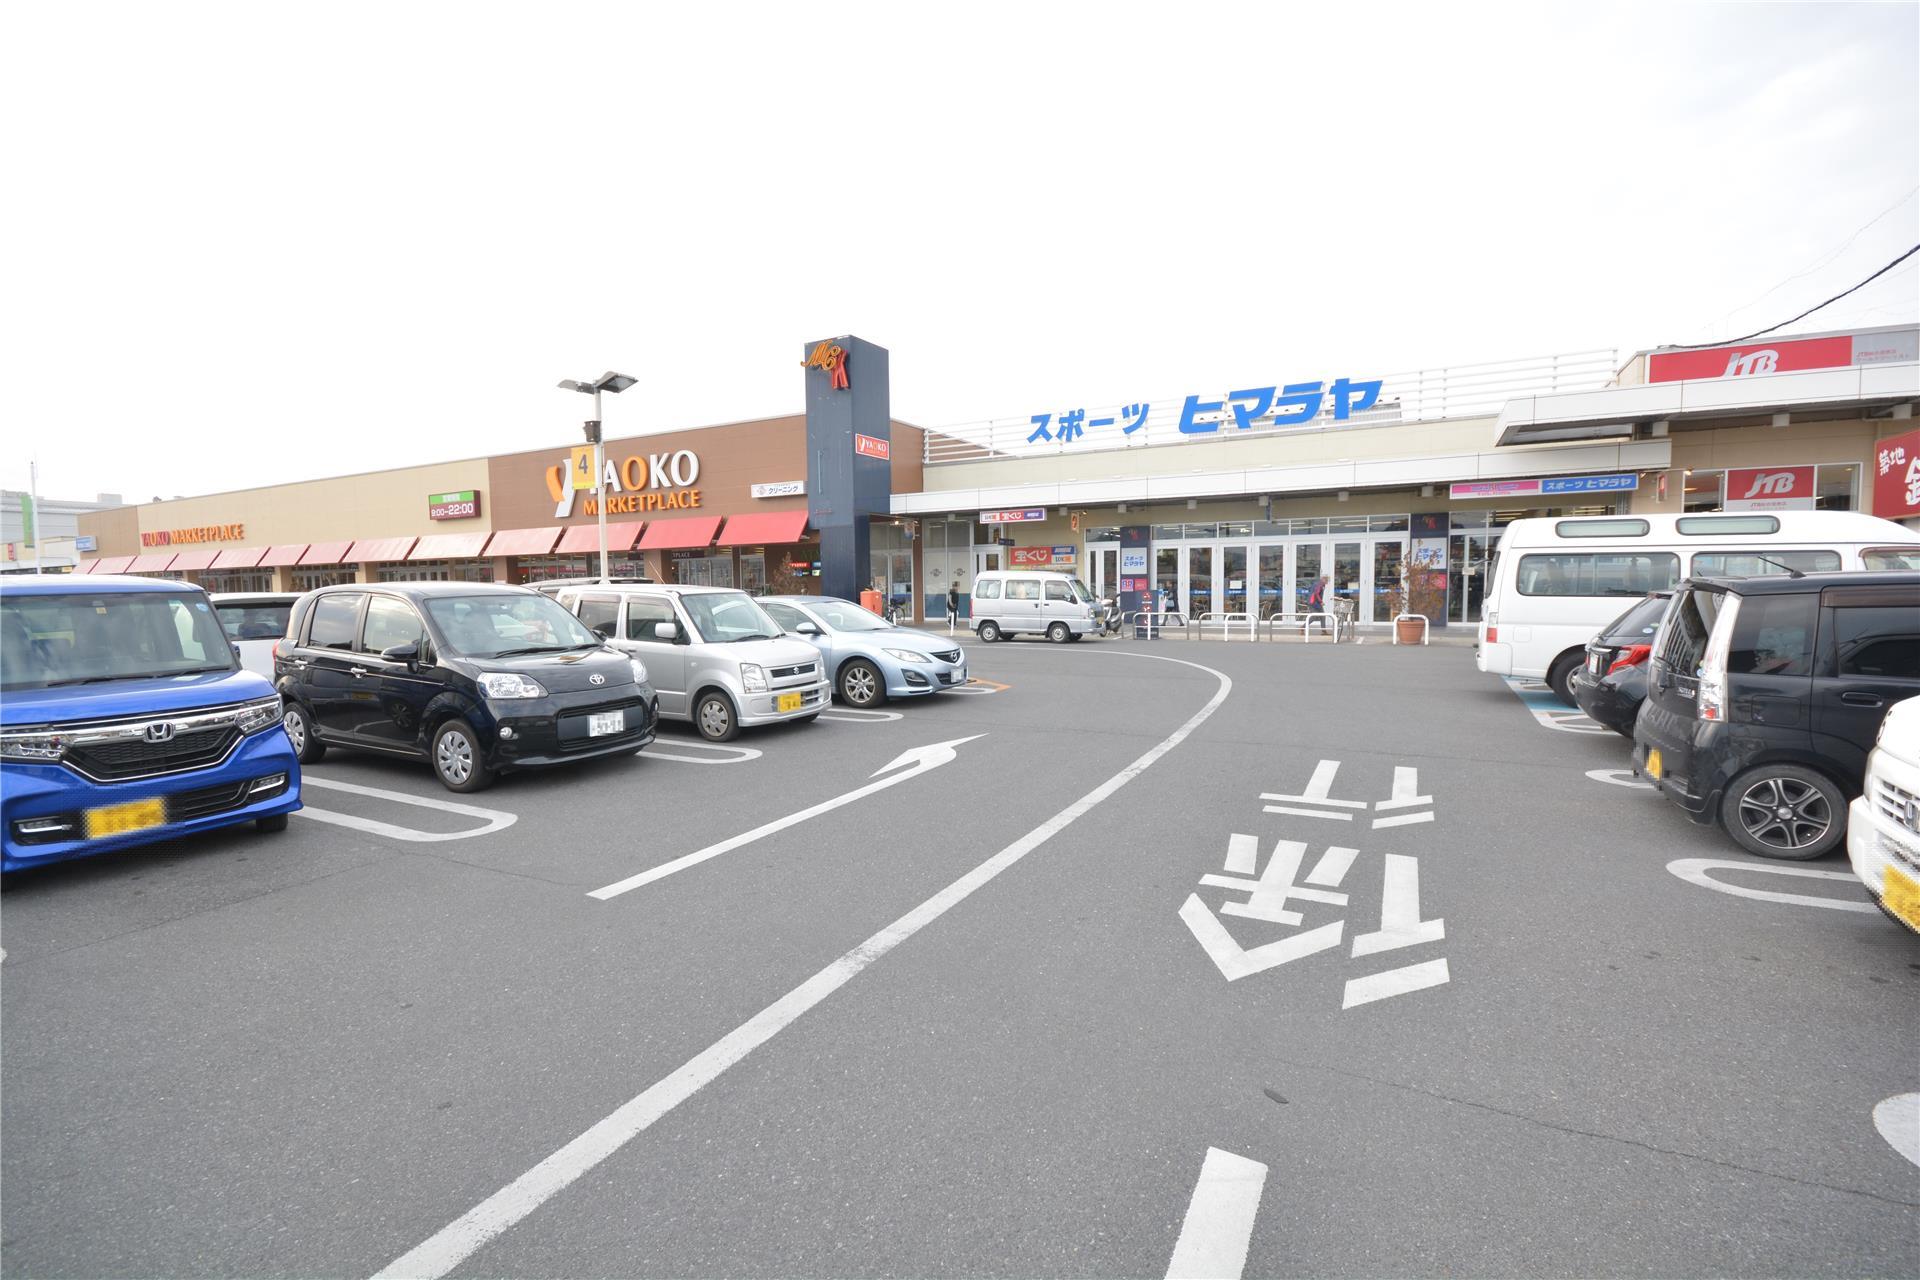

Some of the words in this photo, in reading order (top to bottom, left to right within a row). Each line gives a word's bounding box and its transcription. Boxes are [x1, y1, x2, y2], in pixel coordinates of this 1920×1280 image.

[1723, 349, 1779, 377] JTB
[1027, 402, 1150, 443] スポーツ
[1178, 377, 1384, 435] ヒマラヤ
[578, 454, 588, 475] 4
[1879, 447, 1906, 477] 築地
[768, 485, 799, 495] クリーニング
[1546, 480, 1584, 490] スポーツ
[1586, 477, 1632, 489] ヒマラヤ
[1743, 472, 1796, 499] JTB
[583, 490, 701, 515] MRKETPLACE
[170, 524, 245, 545] MARKETPLACE
[1014, 549, 1048, 563] 宝くじ
